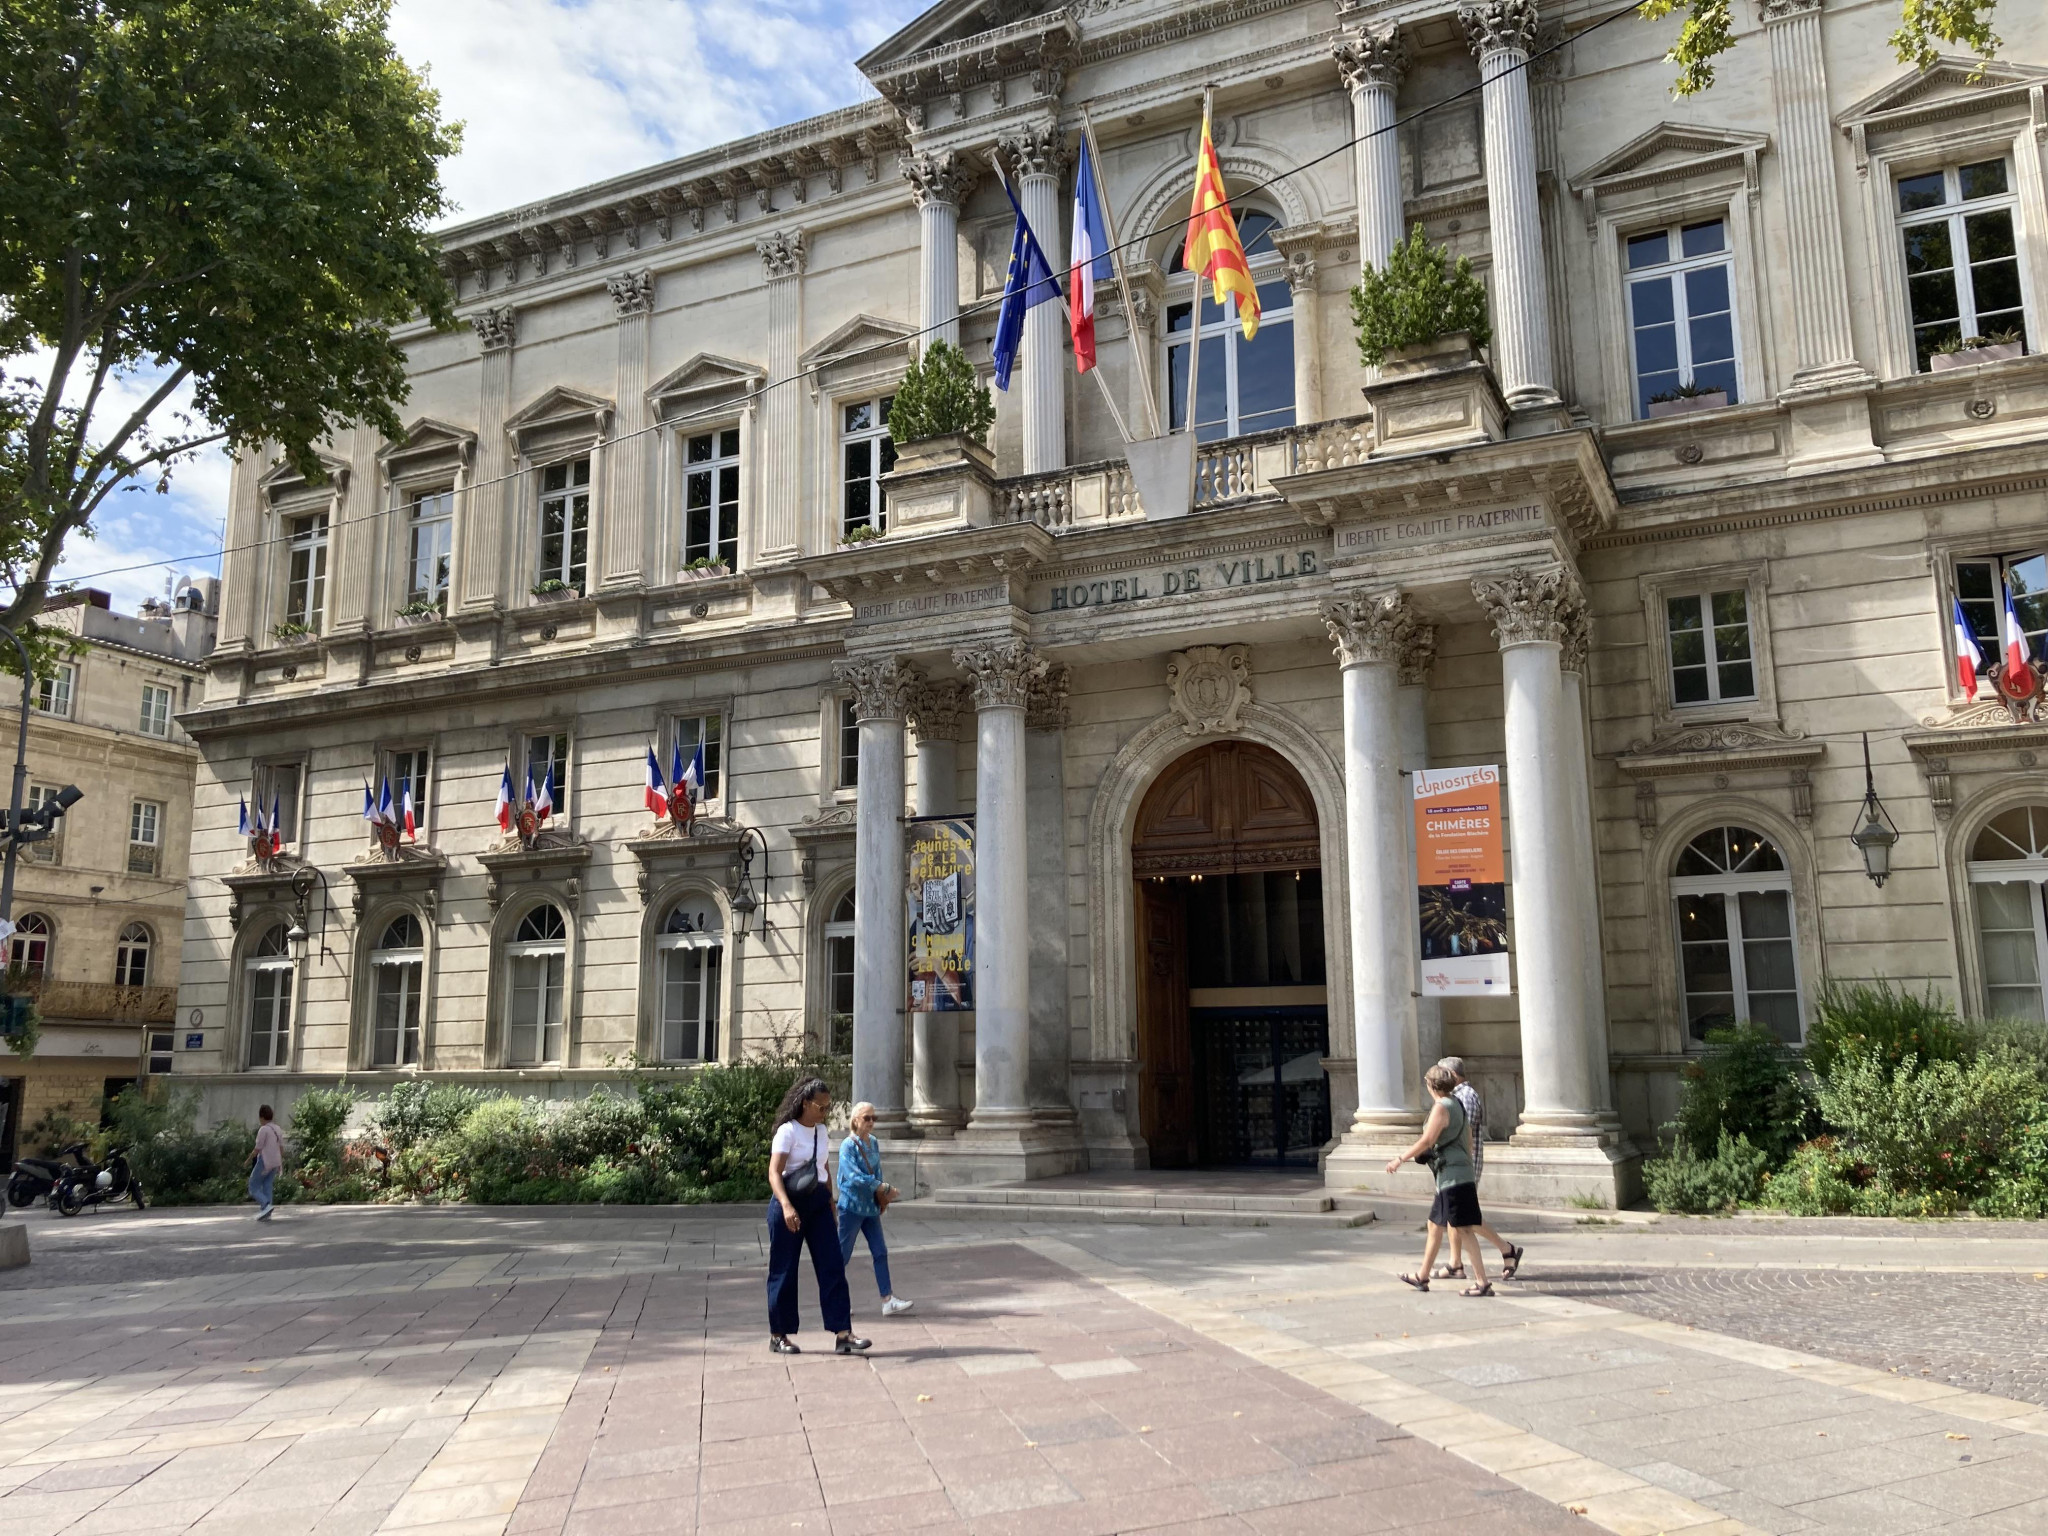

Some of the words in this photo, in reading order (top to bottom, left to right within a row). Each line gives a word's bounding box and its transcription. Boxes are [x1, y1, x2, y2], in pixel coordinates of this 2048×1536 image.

[1336, 527, 1391, 548] LIBERTE
[1397, 518, 1452, 540] EGALITE
[1457, 504, 1542, 531] FRATERNITE
[1050, 576, 1148, 610] HOTEL
[1162, 567, 1201, 596] DE
[1216, 550, 1317, 585] VILLE
[852, 603, 894, 620] LIBERTE
[898, 595, 940, 615] EGALITE
[944, 585, 1006, 606] FRATERNITE
[1416, 767, 1497, 795] CURIOSITÉ(S)
[1426, 816, 1490, 831] CHIMÈRES
